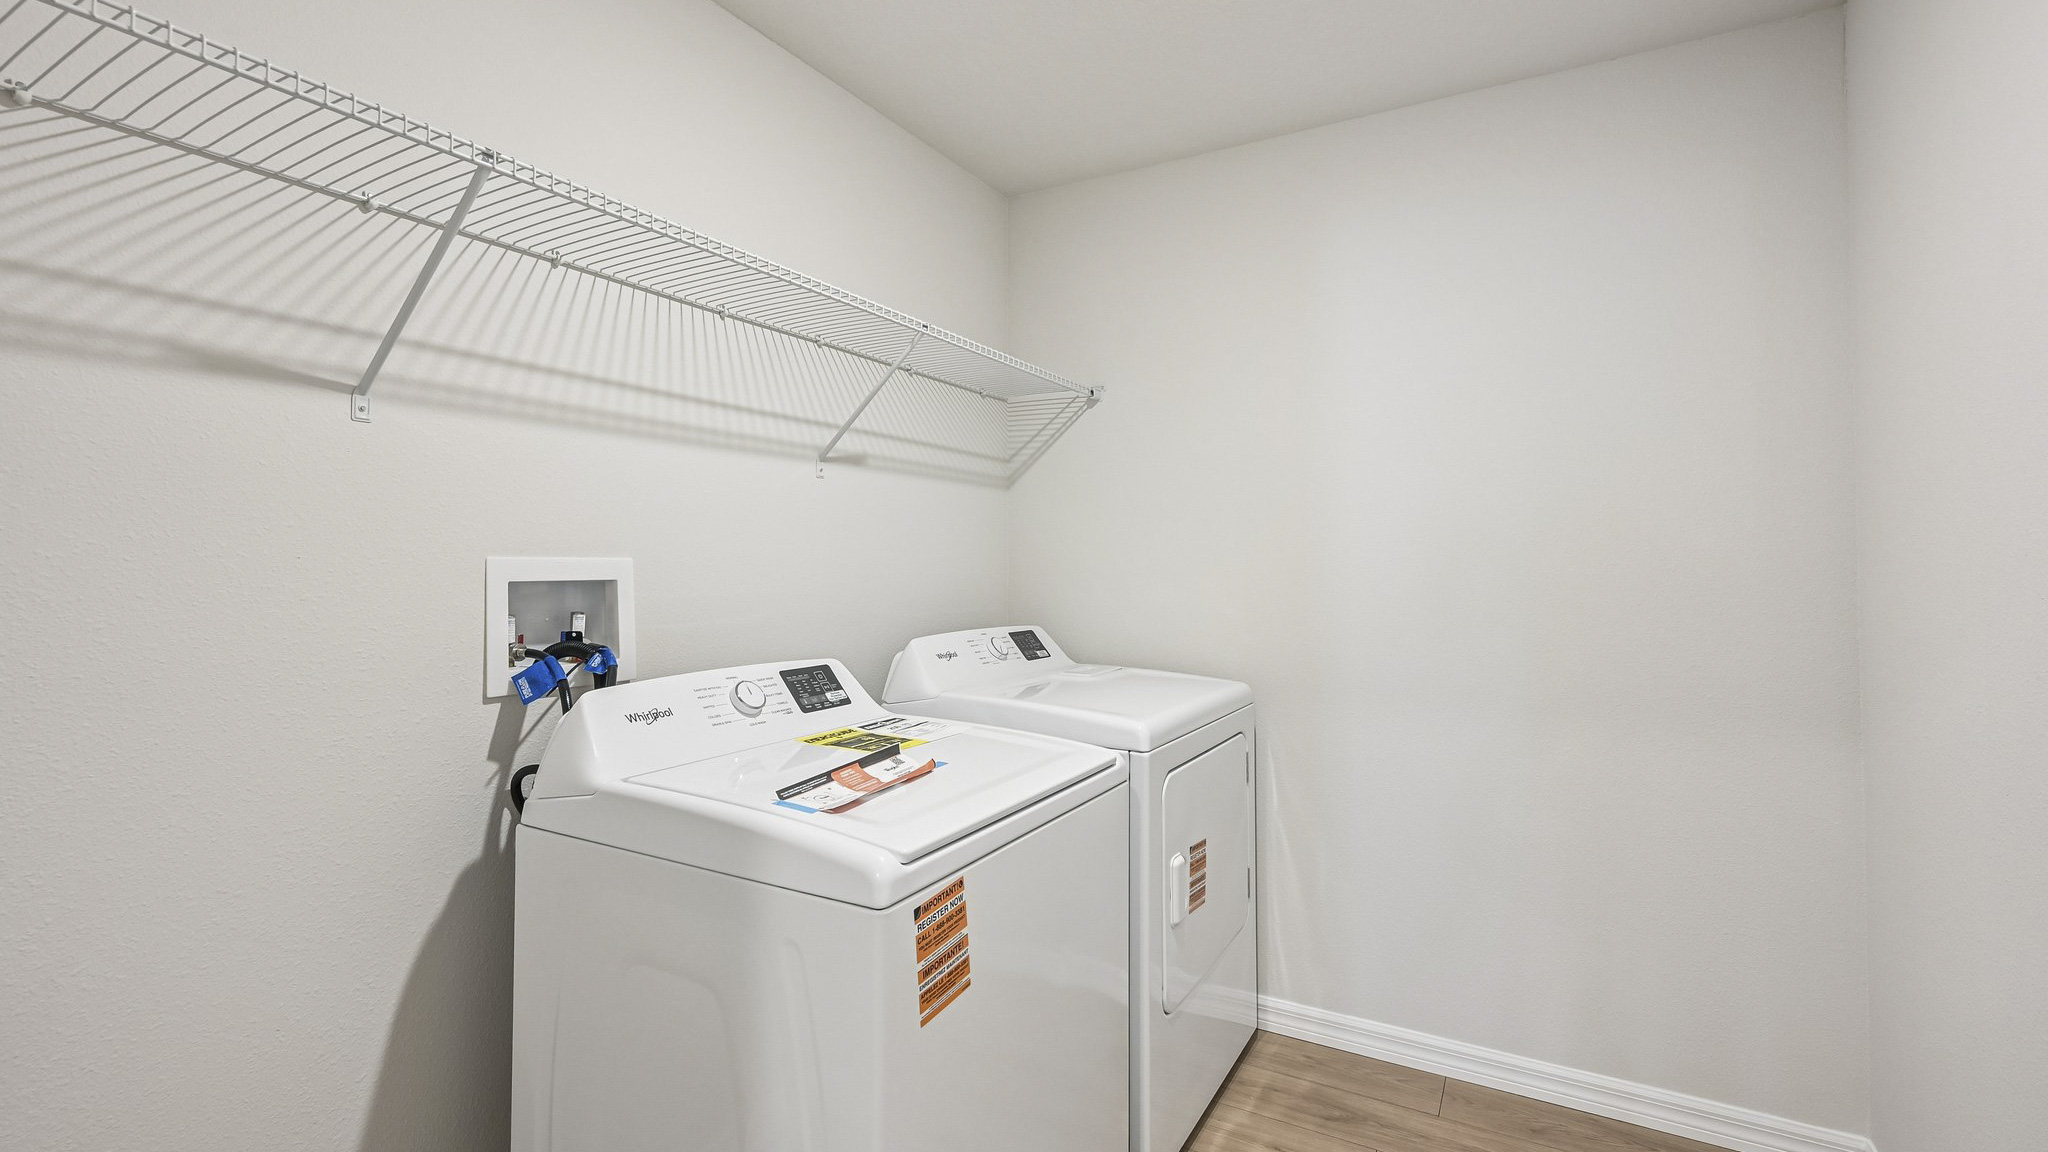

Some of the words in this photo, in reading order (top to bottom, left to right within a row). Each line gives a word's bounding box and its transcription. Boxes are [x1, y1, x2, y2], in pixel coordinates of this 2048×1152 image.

[624, 707, 674, 726] Whirlpool
[916, 904, 949, 933] REGISTER
[949, 892, 965, 910] NOW
[917, 930, 932, 945] CALL
[922, 940, 964, 979] IMPORTANTE!
